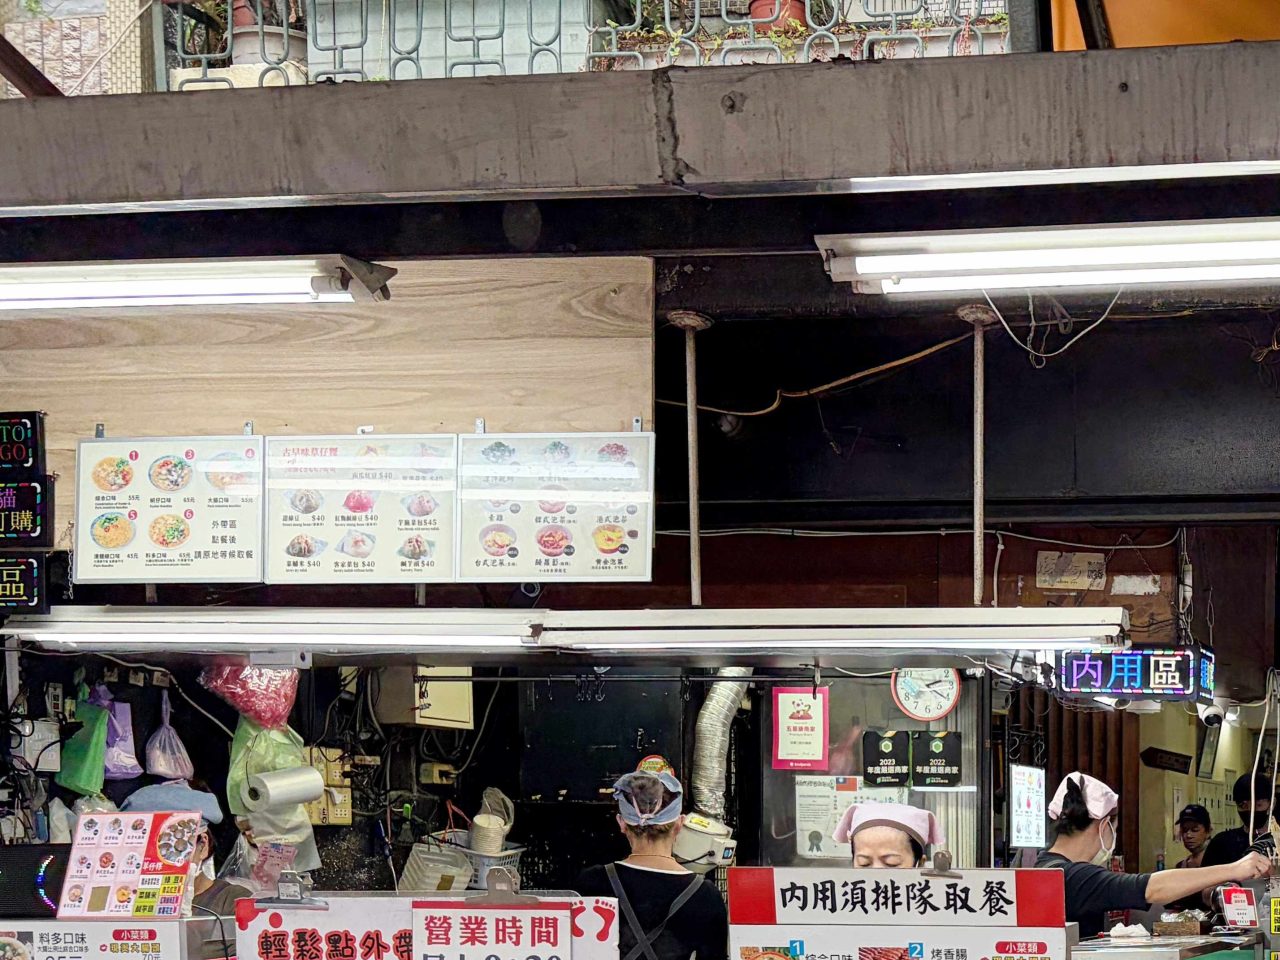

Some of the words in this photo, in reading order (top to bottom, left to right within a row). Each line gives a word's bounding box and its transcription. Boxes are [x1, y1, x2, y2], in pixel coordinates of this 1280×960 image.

[212, 520, 237, 529] 外帶區
[212, 536, 236, 544] 點餐後
[194, 550, 253, 559] 請原地等候取餐
[1072, 653, 1184, 689] 內用區
[779, 878, 1015, 917] 內用須排隊取餐
[121, 931, 149, 940] 小菜類
[424, 915, 559, 947] 營業時間
[39, 932, 87, 944] 料多口味
[911, 944, 922, 957] 2
[1006, 942, 1038, 953] 小菜類
[930, 949, 967, 960] 烤香腸
